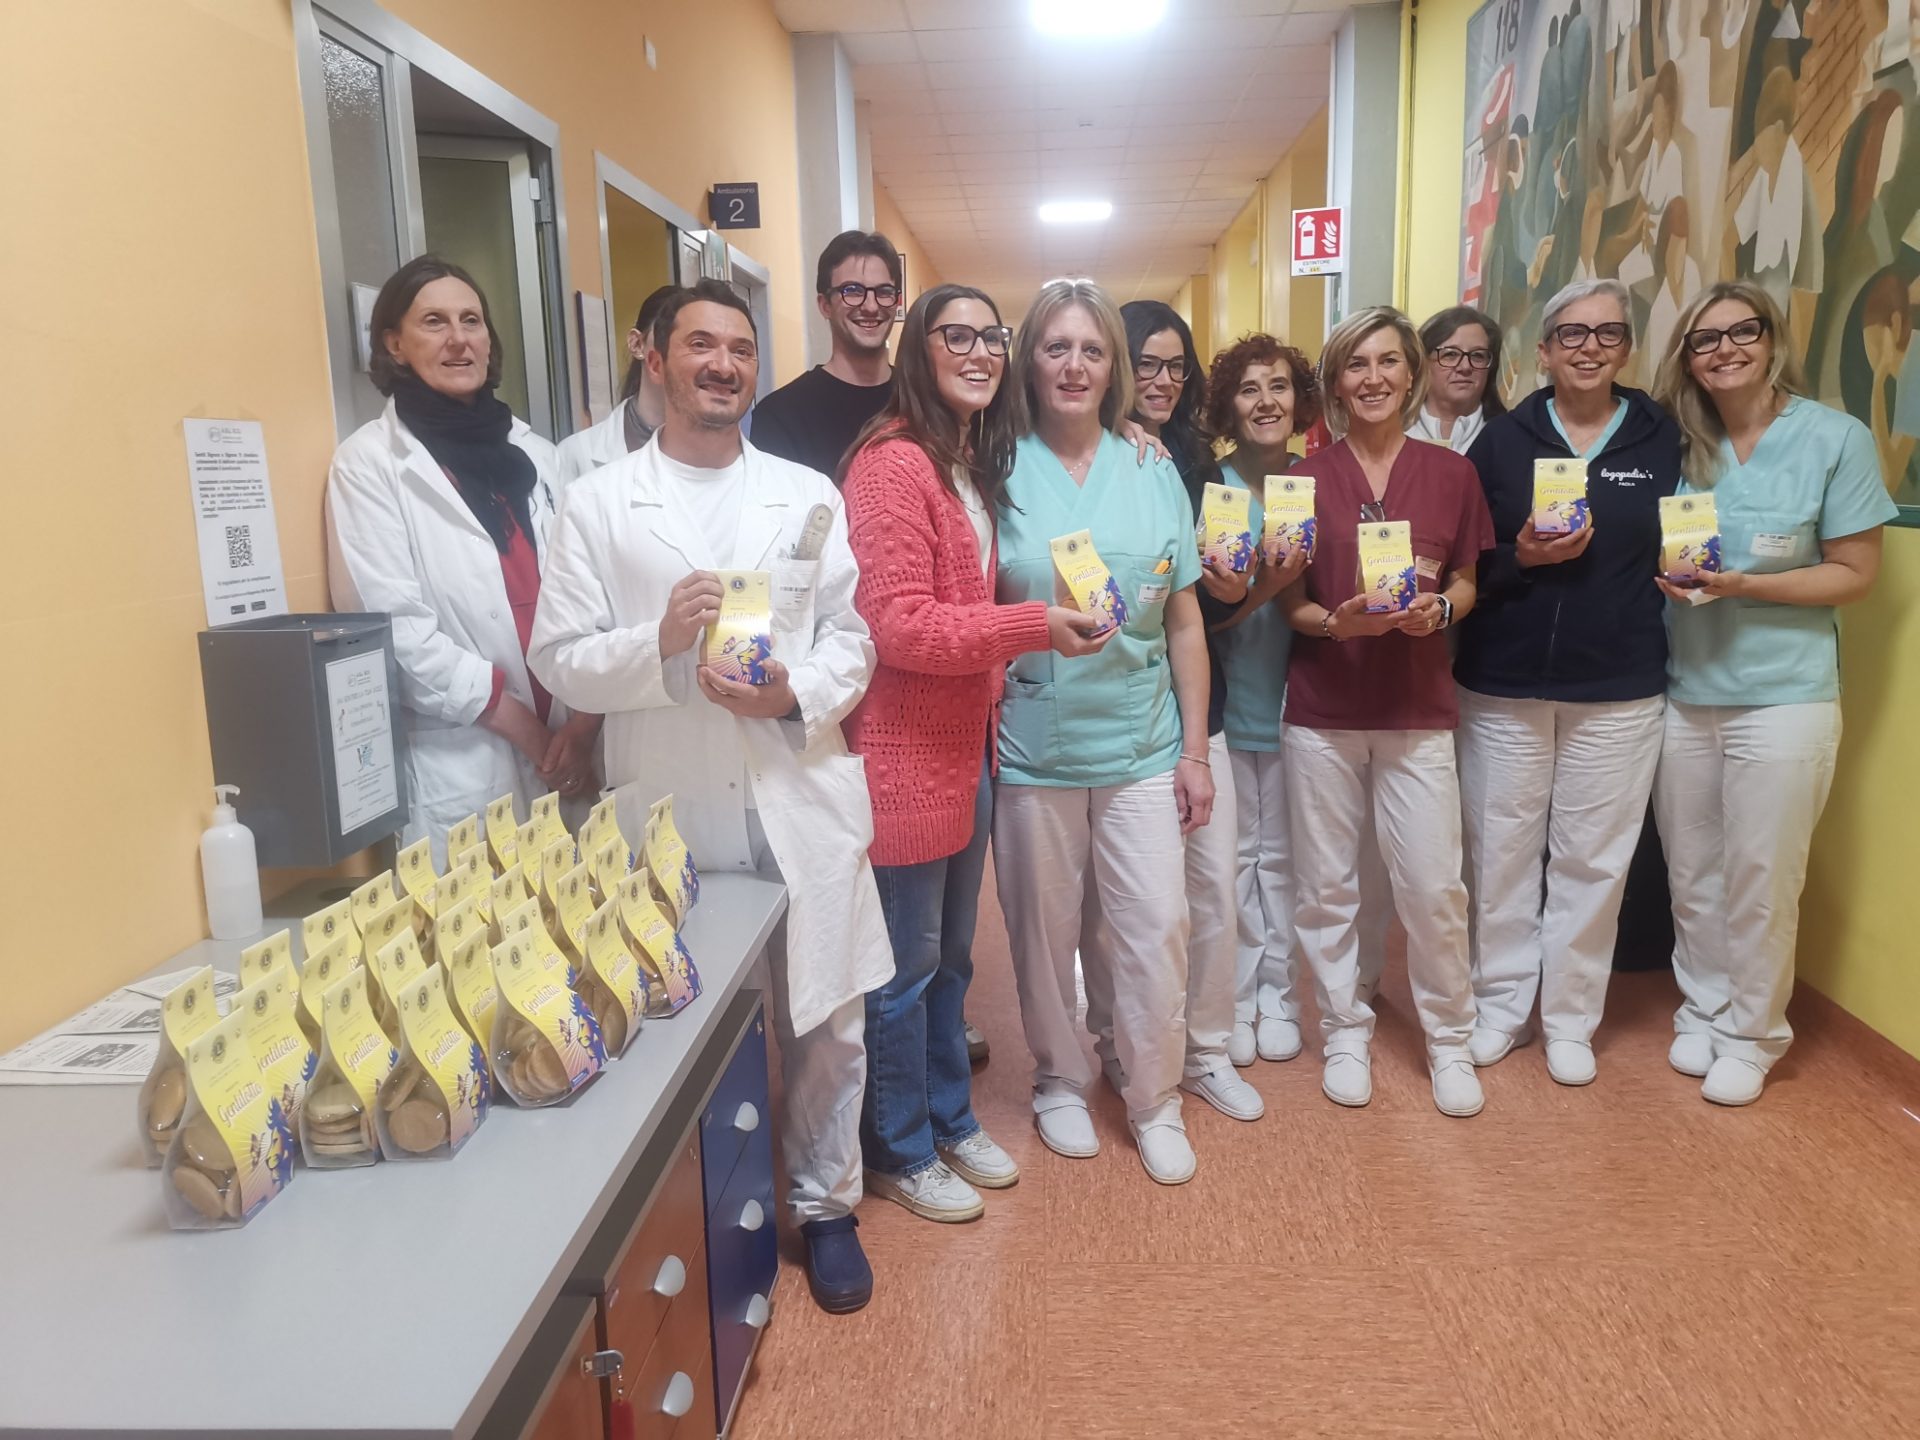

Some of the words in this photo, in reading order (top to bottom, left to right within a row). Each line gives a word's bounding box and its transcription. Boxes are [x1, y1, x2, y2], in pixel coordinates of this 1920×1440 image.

[1495, 0, 1520, 63] 118
[717, 187, 756, 195] Ambulatorio
[729, 198, 745, 223] 2
